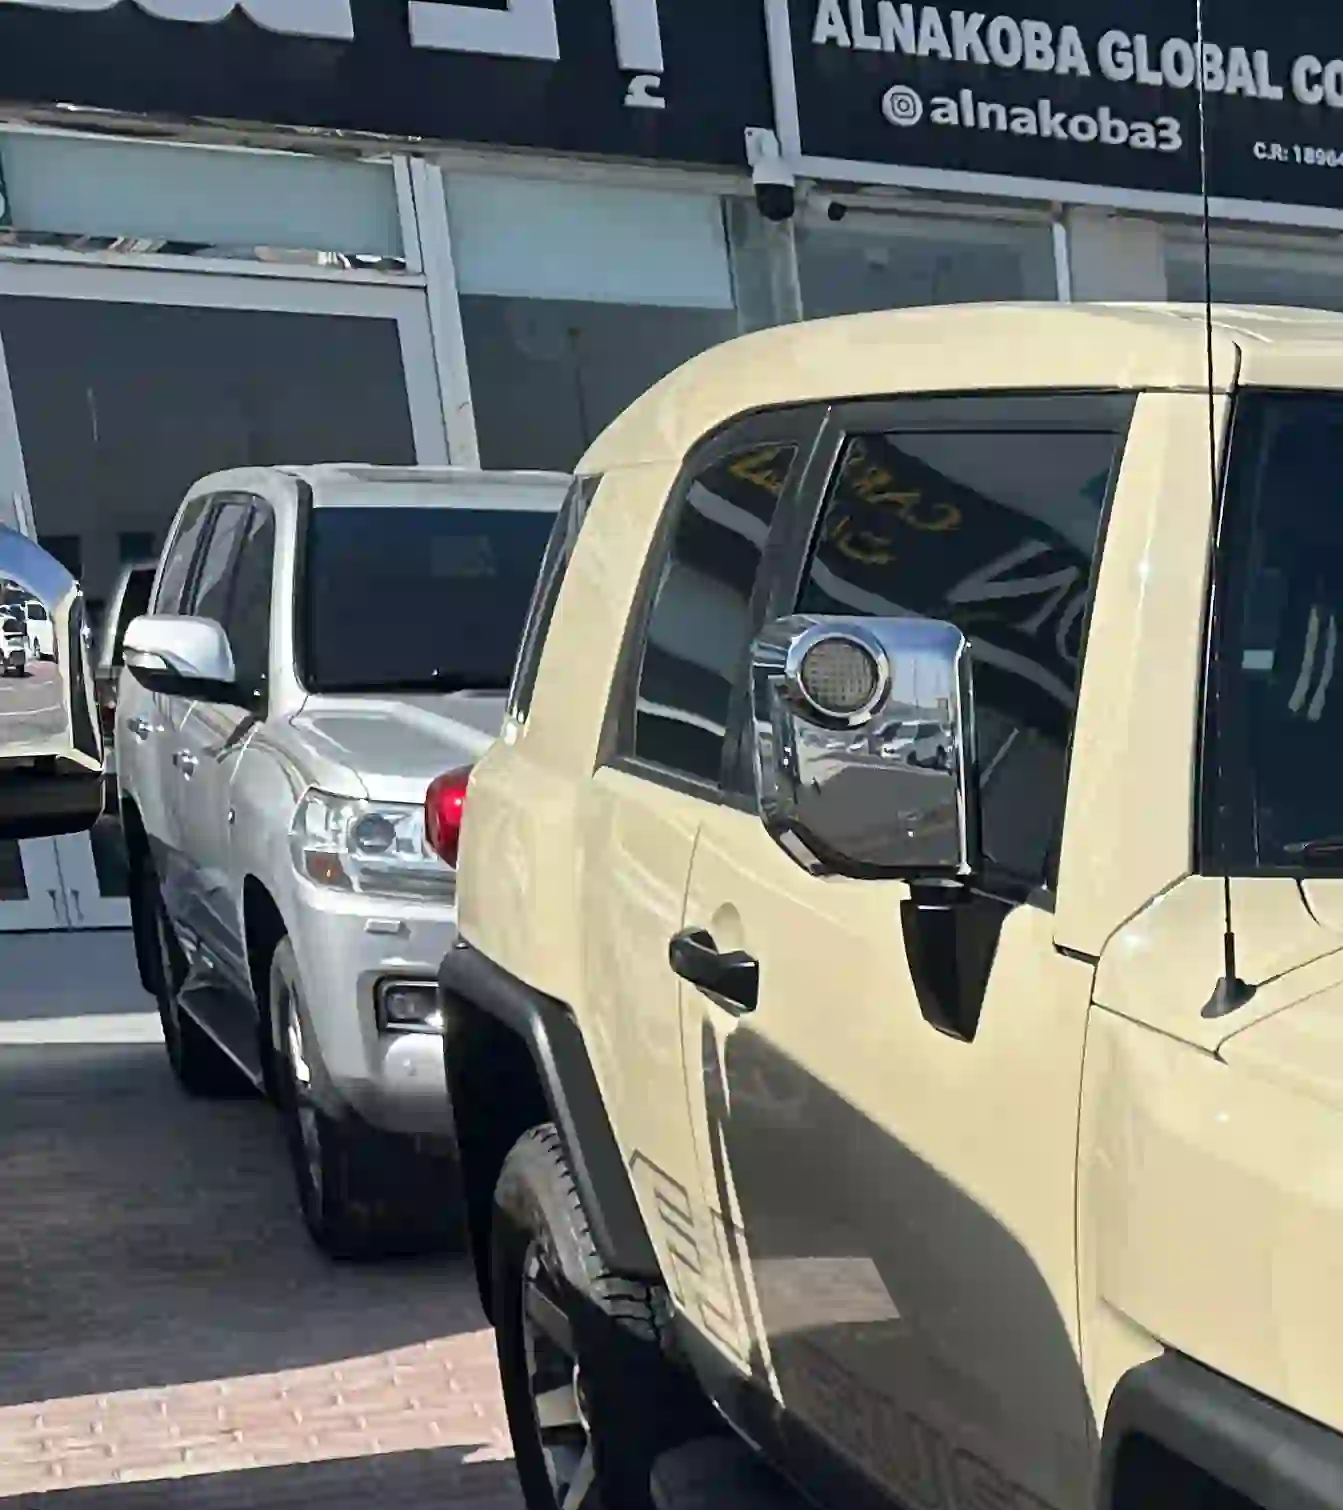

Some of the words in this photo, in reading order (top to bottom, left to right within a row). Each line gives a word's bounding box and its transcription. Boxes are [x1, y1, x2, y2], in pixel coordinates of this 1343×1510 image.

[812, 0, 1090, 76] ALNAKOBA
[1098, 29, 1283, 101] GLOBAL
[930, 88, 1183, 152] alnakoba3
